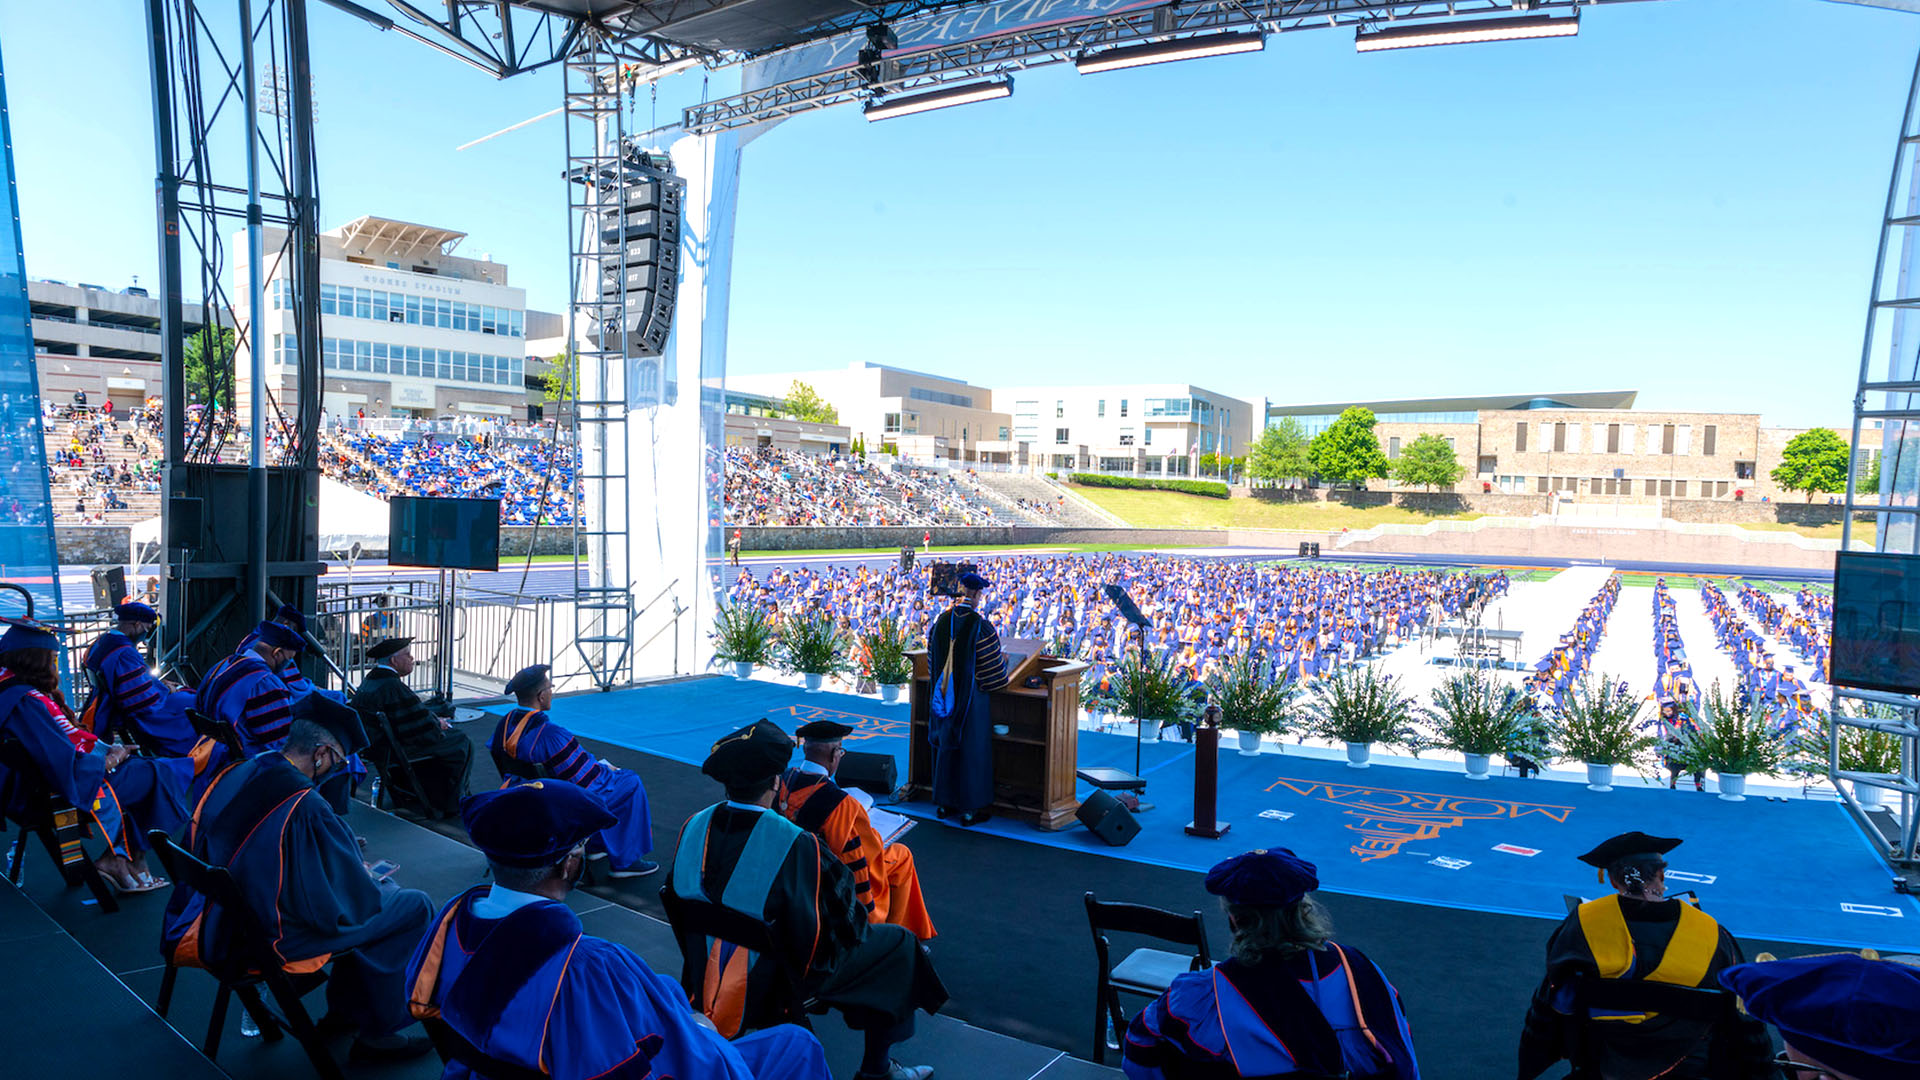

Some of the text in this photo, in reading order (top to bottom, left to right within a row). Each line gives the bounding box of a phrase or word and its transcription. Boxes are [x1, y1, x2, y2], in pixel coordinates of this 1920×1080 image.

[364, 275, 461, 295] HUGHES STADIUM
[1264, 780, 1573, 823] MORGAN
